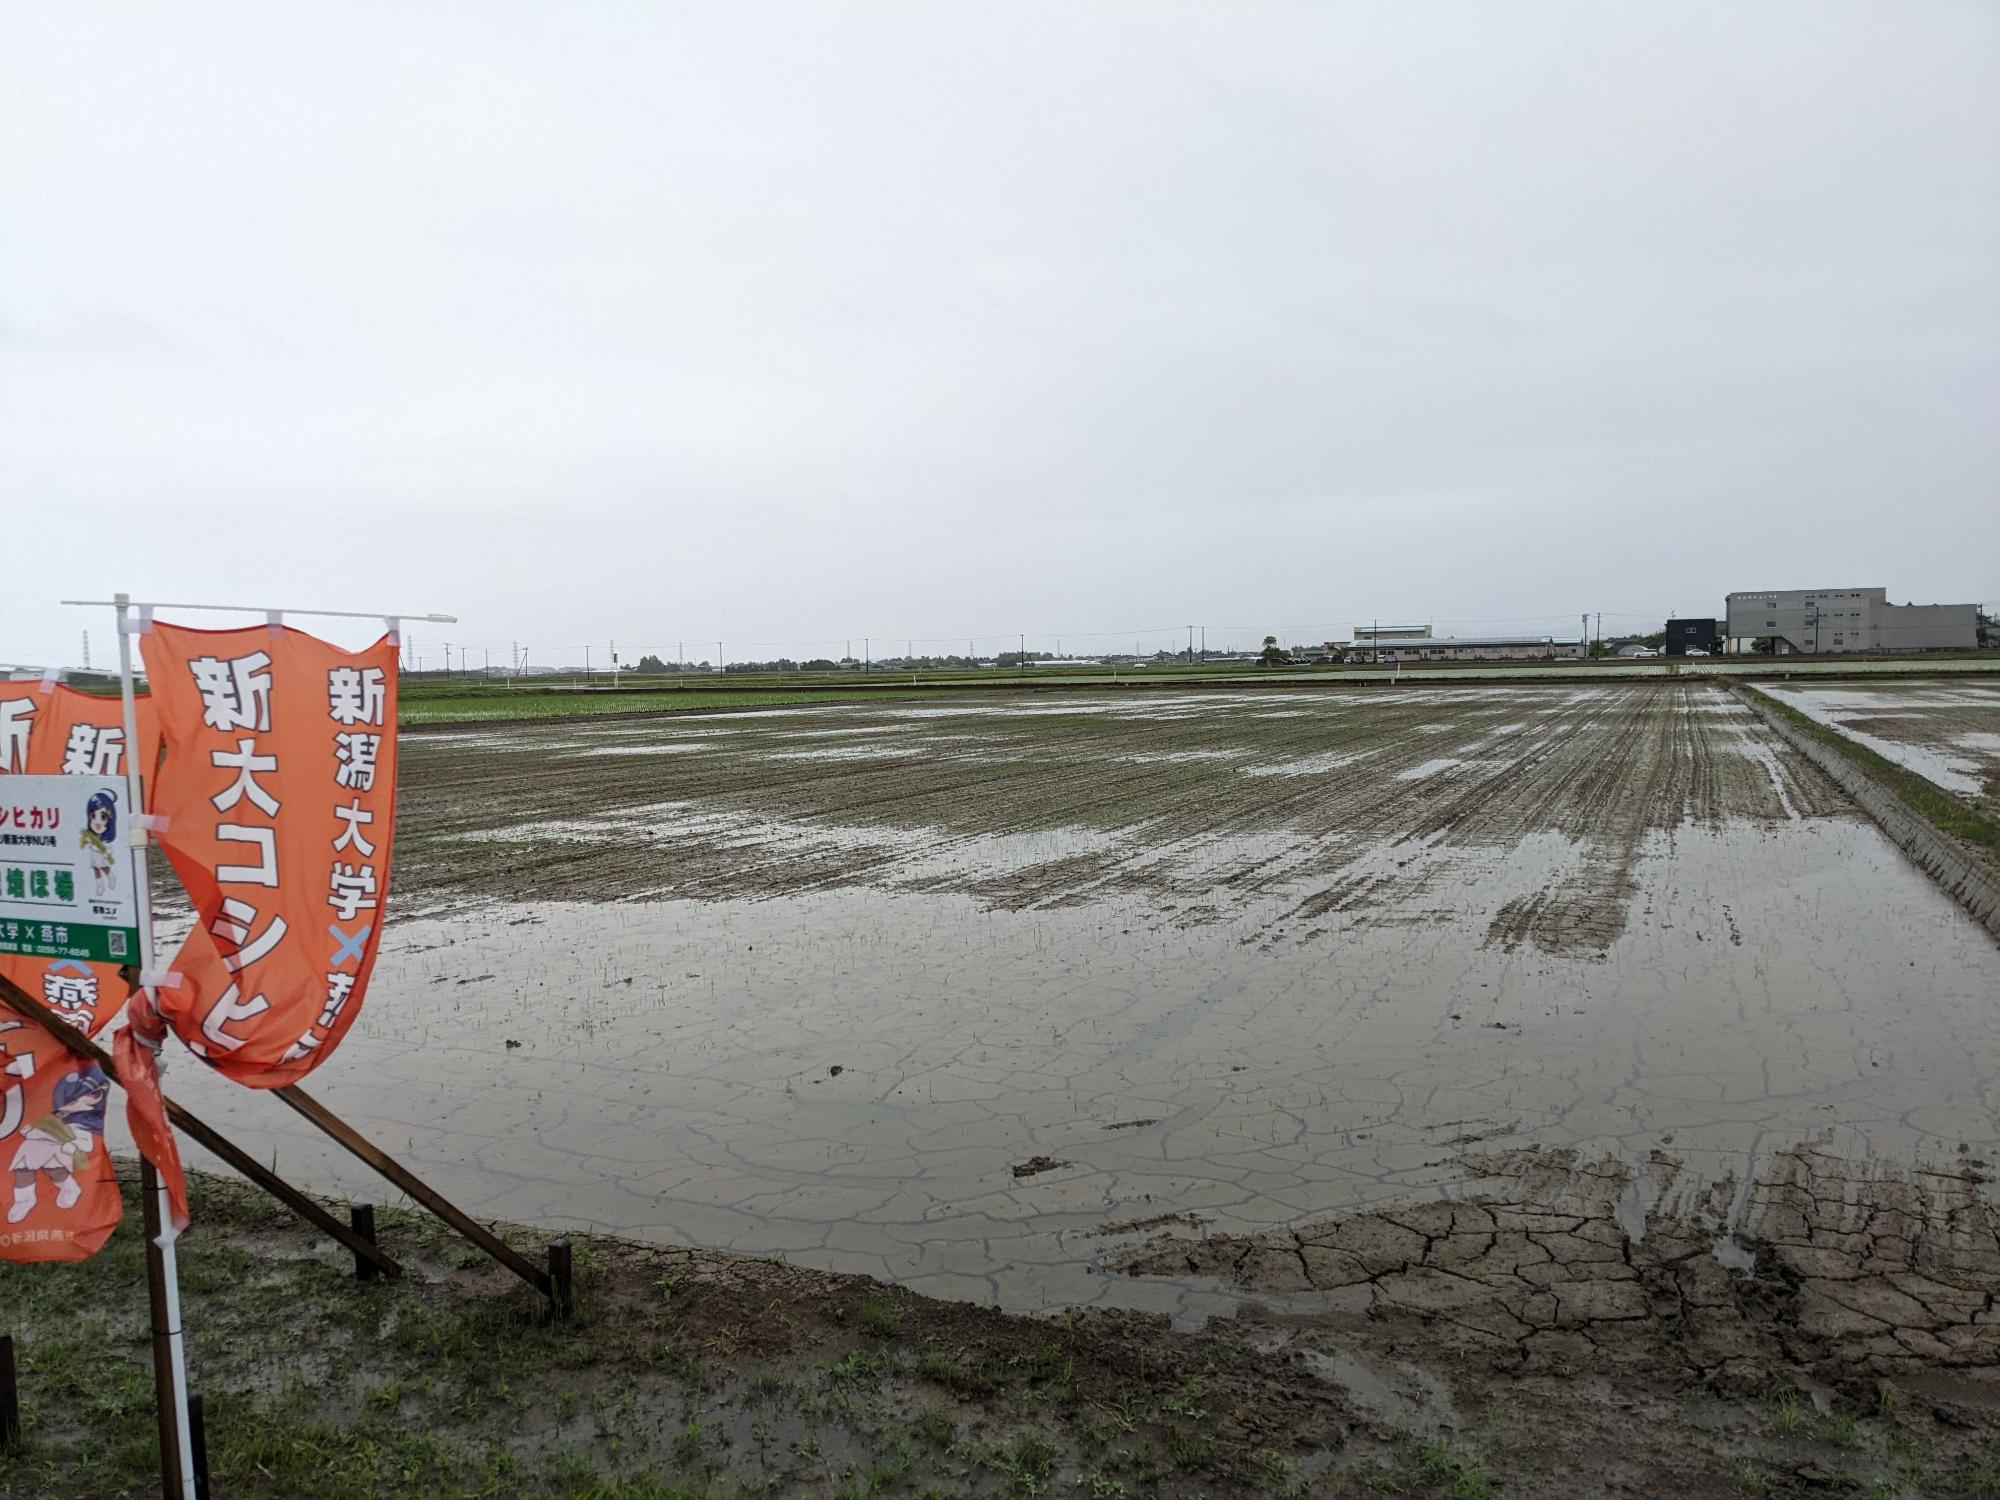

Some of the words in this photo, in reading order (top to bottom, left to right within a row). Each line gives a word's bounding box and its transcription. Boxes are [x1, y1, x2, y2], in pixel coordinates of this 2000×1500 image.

[188, 651, 289, 1055] 新大コシヒ
